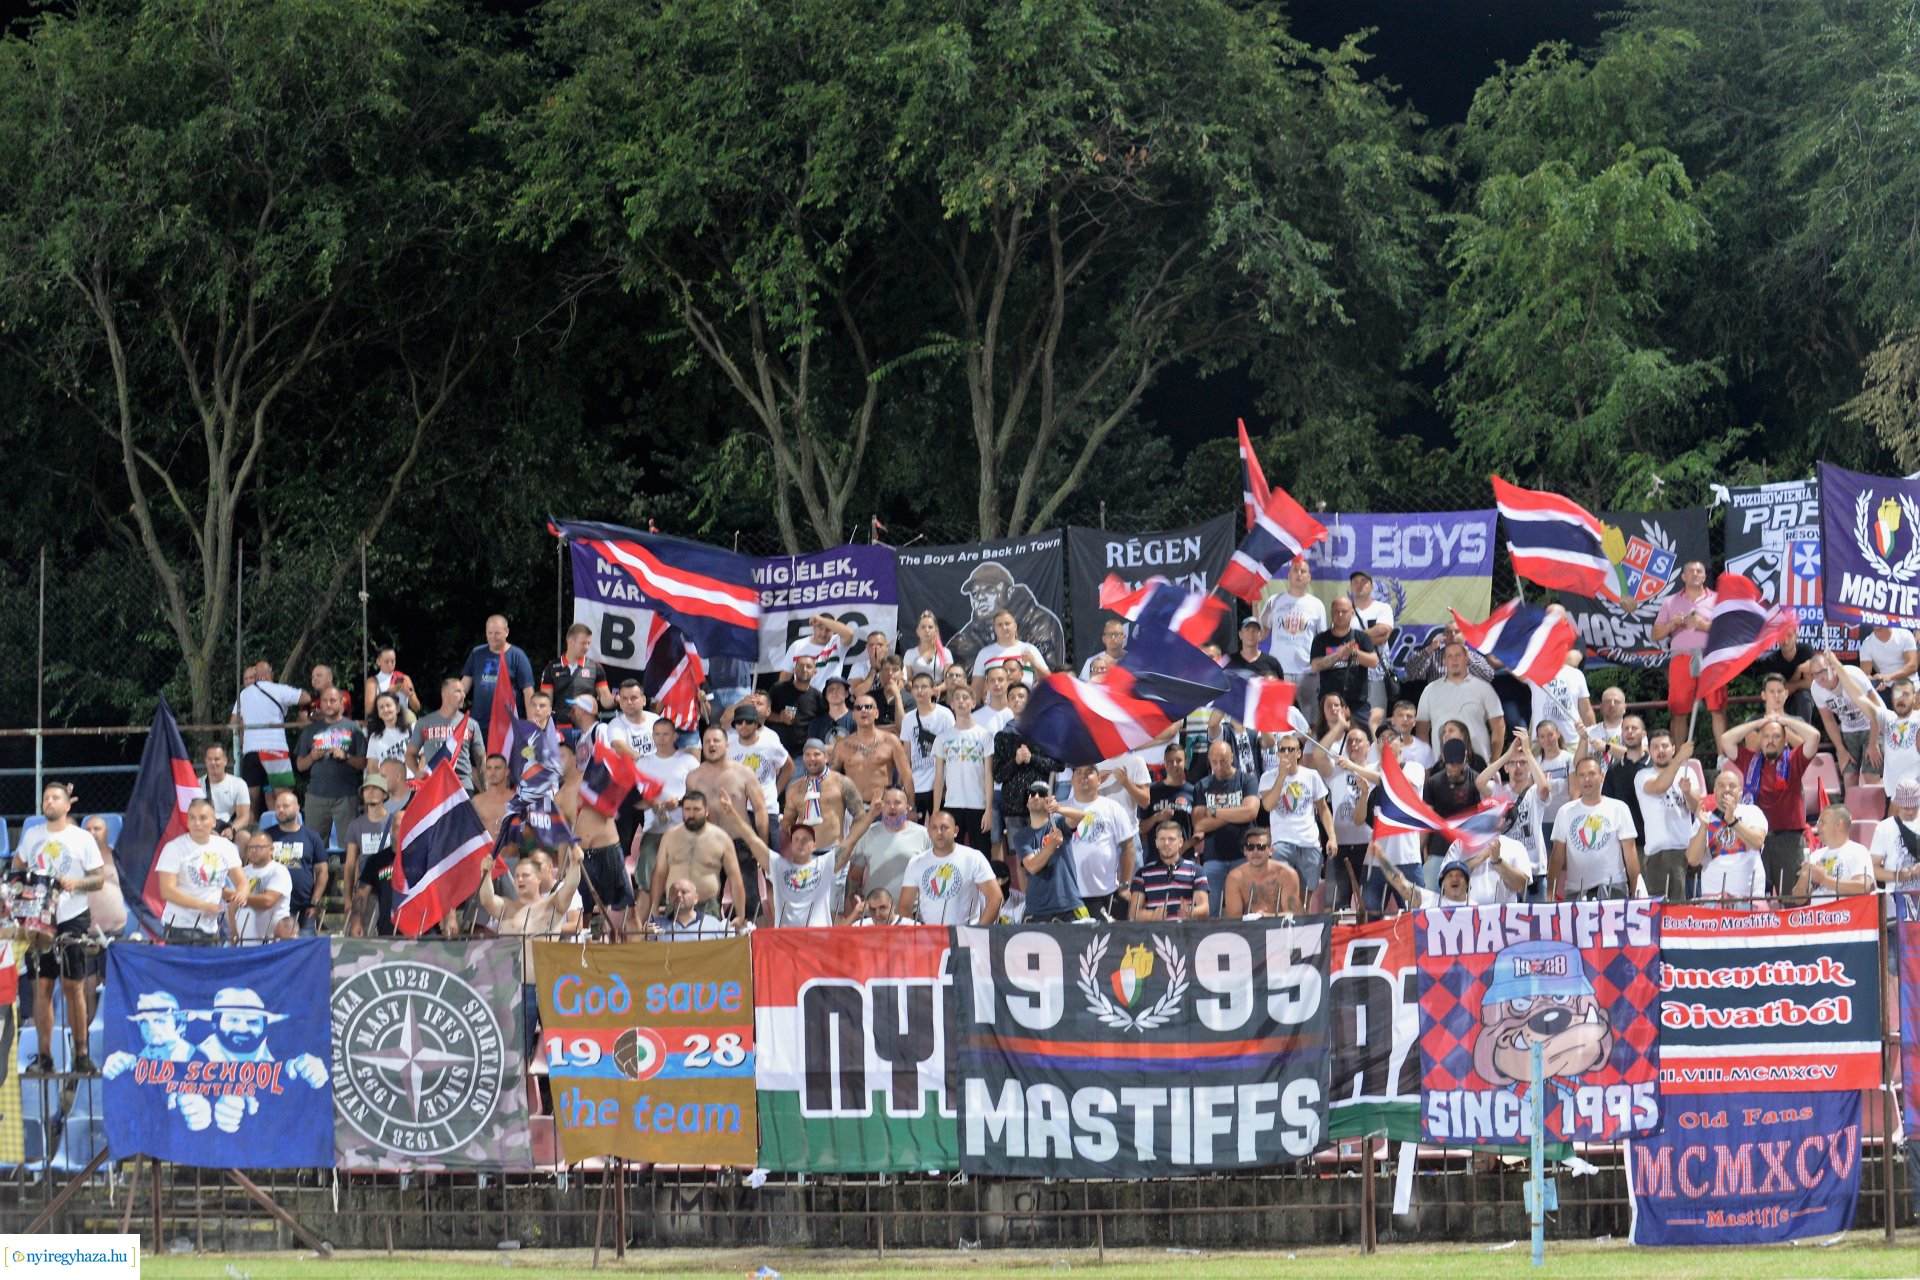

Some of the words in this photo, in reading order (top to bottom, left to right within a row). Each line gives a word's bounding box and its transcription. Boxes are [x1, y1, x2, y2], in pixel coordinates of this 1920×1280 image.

[1733, 487, 1812, 508] POZDROWIENIA
[899, 555, 921, 565] The
[924, 555, 955, 566] Boys
[957, 551, 979, 562] Are
[982, 548, 1012, 559] Back
[1030, 538, 1061, 551] Town
[1105, 536, 1201, 568] RÉGEN
[1281, 525, 1356, 569] AD
[1371, 521, 1487, 569] BOYS
[796, 557, 858, 582] ÉLEK,
[1839, 572, 1920, 617] MASTIF
[1425, 901, 1652, 957] MASTIFFS
[1663, 916, 1718, 933] Eastern
[1720, 914, 1780, 930] Mastiffs
[1788, 911, 1814, 926] Old
[1817, 909, 1850, 925] Fans
[384, 968, 430, 990] 1928
[1660, 956, 1856, 993] imentünk
[552, 973, 632, 1018] God
[645, 977, 743, 1015] save
[1661, 996, 1852, 1030] divatból
[462, 999, 500, 1116] SPARTACUS
[547, 1037, 602, 1068] 19
[683, 1032, 747, 1069] 28
[134, 1057, 174, 1085] OLD
[184, 1061, 284, 1095] SCHOOL
[356, 1066, 398, 1112] 1995
[424, 1065, 469, 1119] SINCE
[560, 1085, 620, 1129] the
[632, 1093, 742, 1134] team
[965, 1078, 1321, 1166] MASTIFFS
[1556, 1081, 1659, 1135] 1995
[1679, 1111, 1730, 1130] Old
[1742, 1106, 1814, 1127] Fans
[392, 1127, 440, 1151] 1928
[1634, 1125, 1858, 1198] MCMXCV
[1706, 1205, 1790, 1228] Mastiffs
